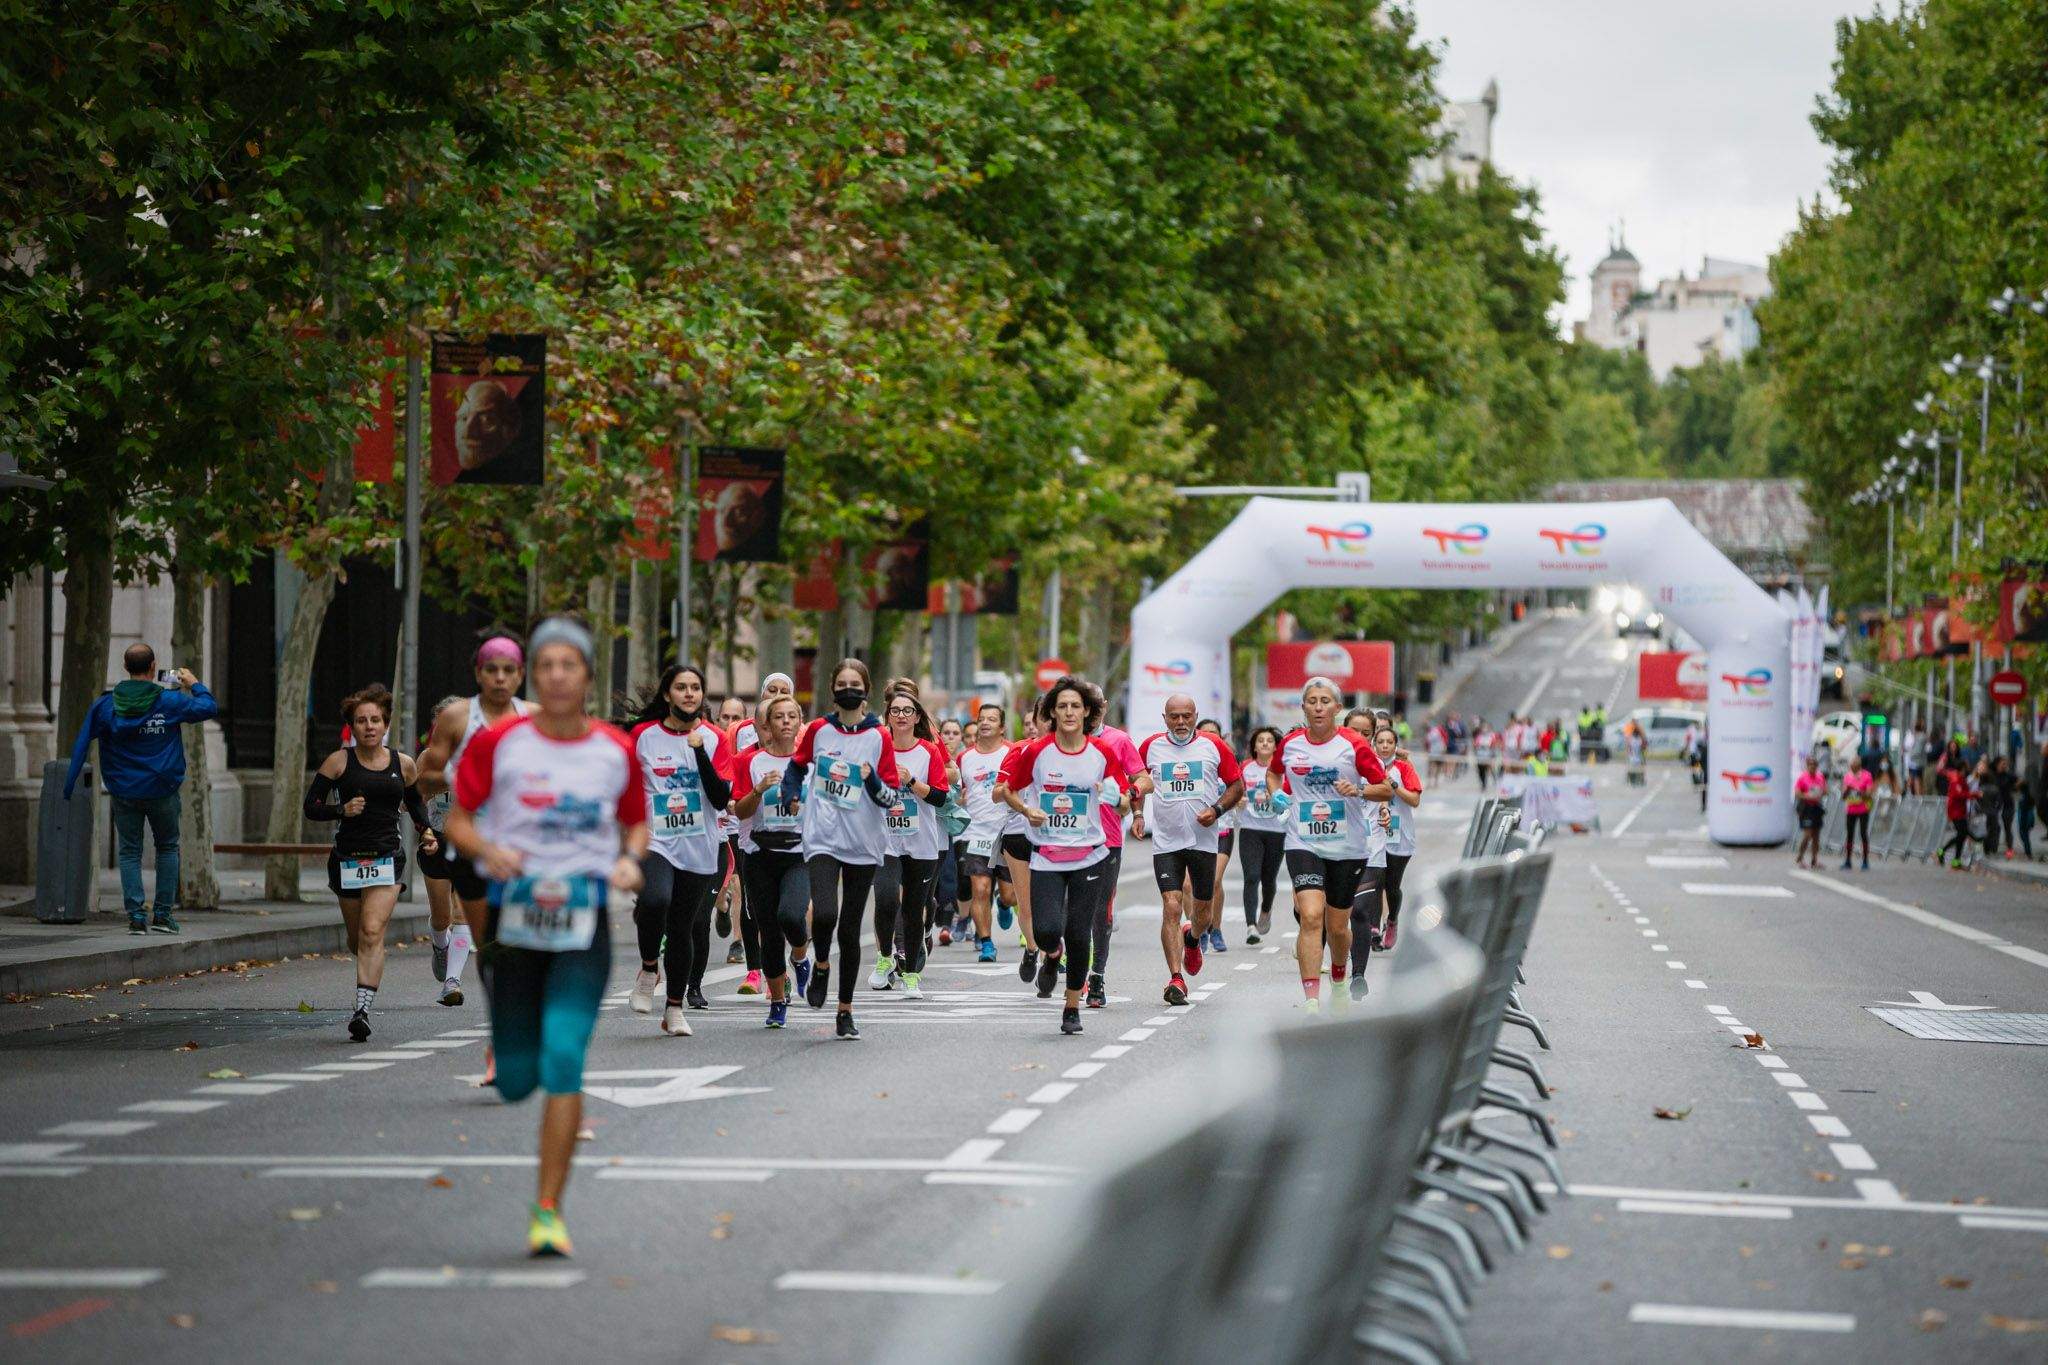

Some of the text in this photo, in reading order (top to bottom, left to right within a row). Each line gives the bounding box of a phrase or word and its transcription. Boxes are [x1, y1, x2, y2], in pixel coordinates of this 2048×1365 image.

[824, 780, 851, 798] 1047
[1170, 780, 1195, 792] 1075
[665, 812, 695, 828] 1044
[885, 816, 911, 828] 1045
[1048, 815, 1077, 828] 1032
[1308, 821, 1337, 835] 1062
[977, 840, 992, 849] 105
[357, 866, 379, 879] 475
